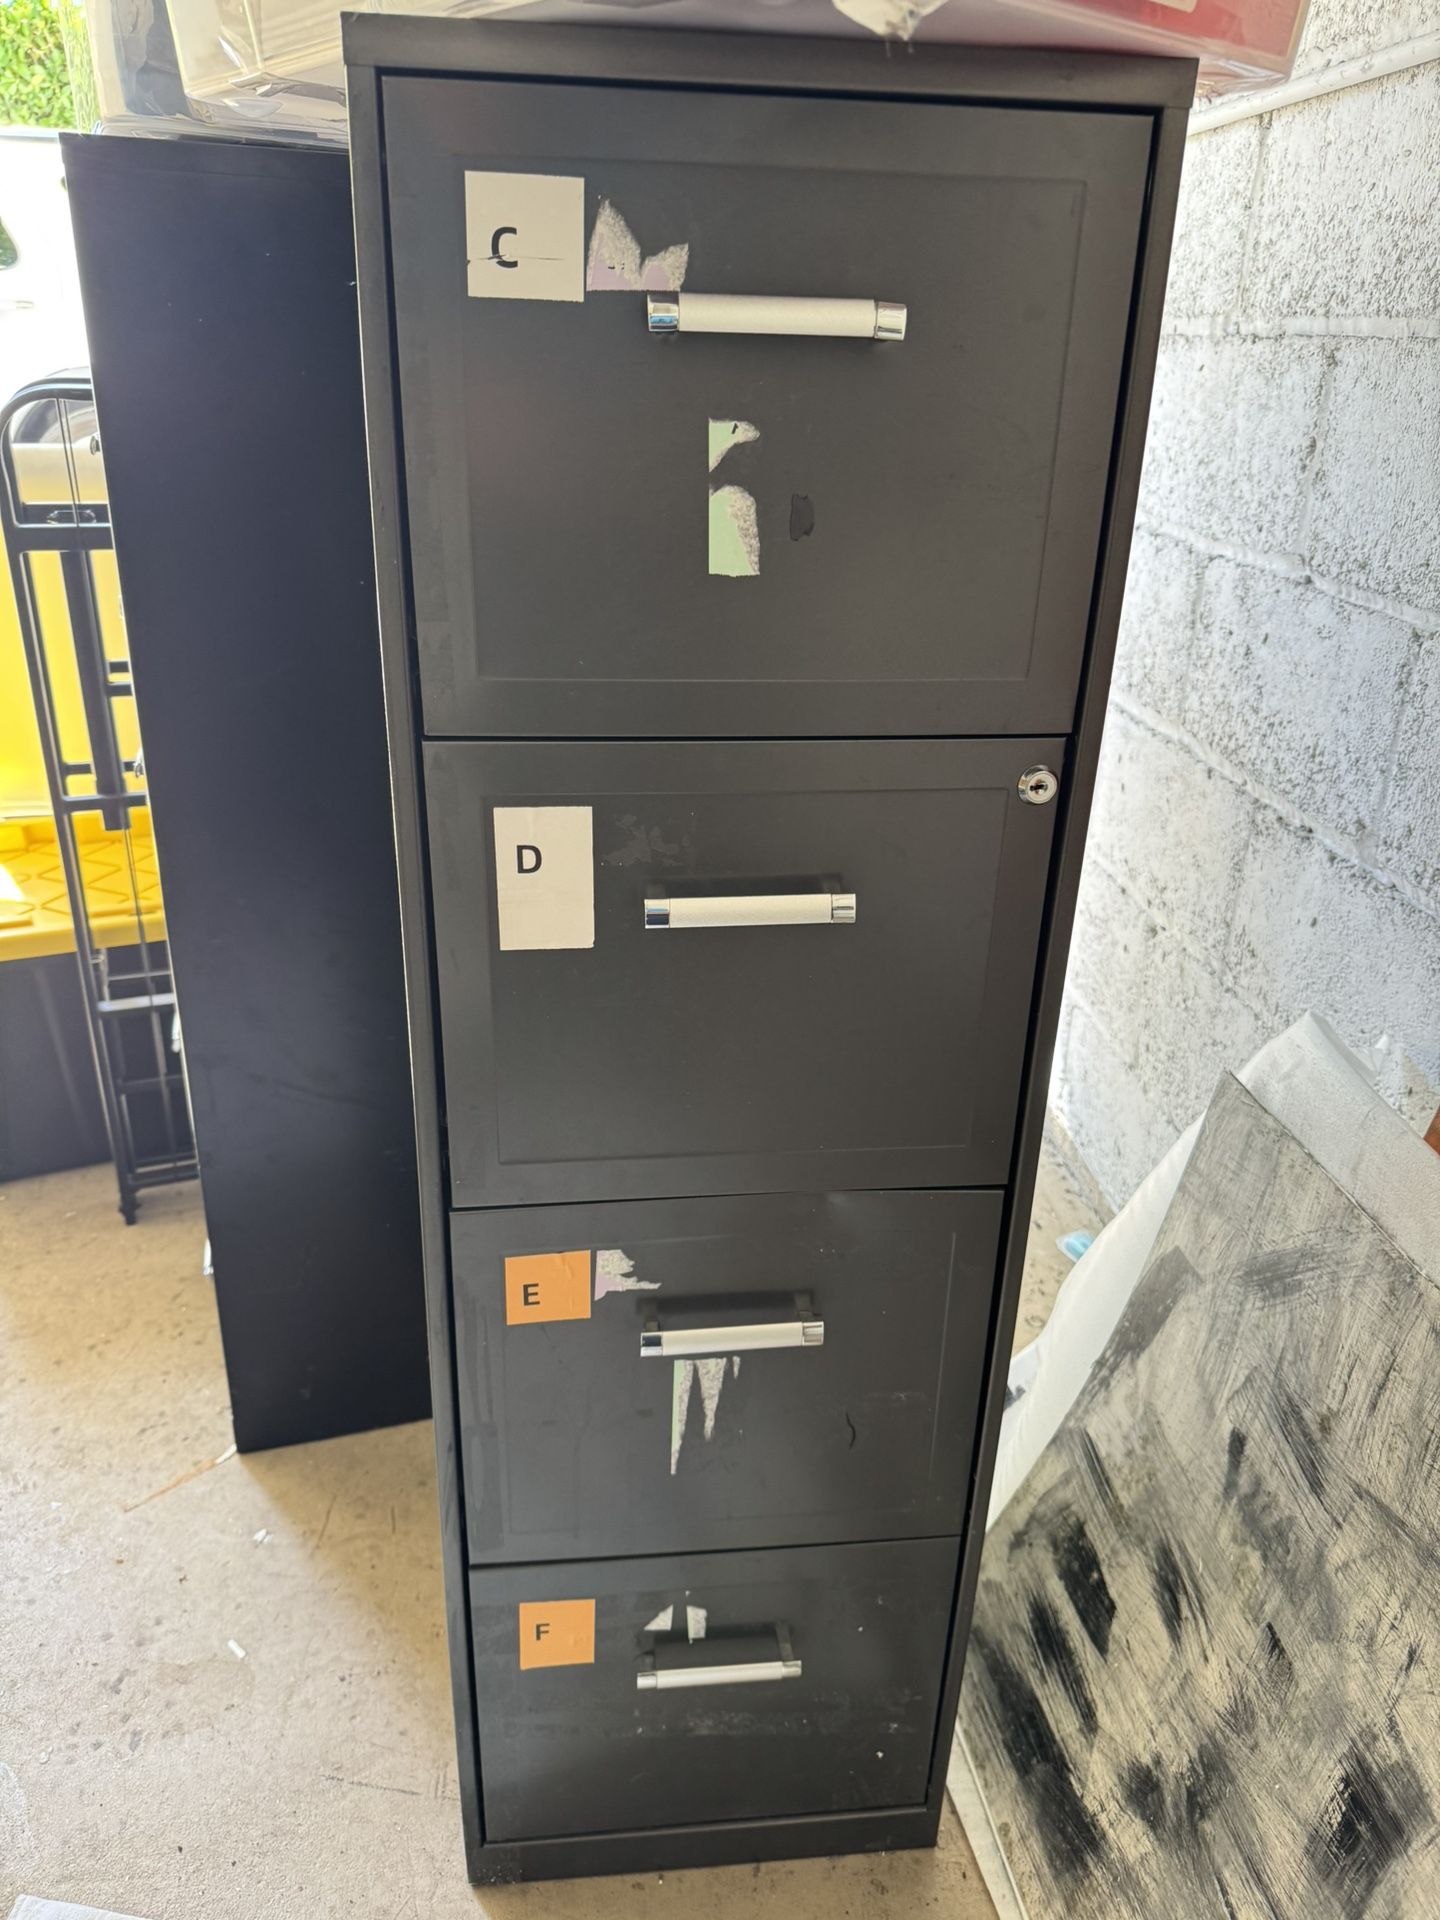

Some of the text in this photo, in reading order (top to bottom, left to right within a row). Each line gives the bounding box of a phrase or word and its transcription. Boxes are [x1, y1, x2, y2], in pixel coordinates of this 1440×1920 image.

[490, 226, 518, 269] C
[516, 844, 542, 874] D
[522, 1283, 541, 1307] E
[535, 1622, 550, 1641] F
